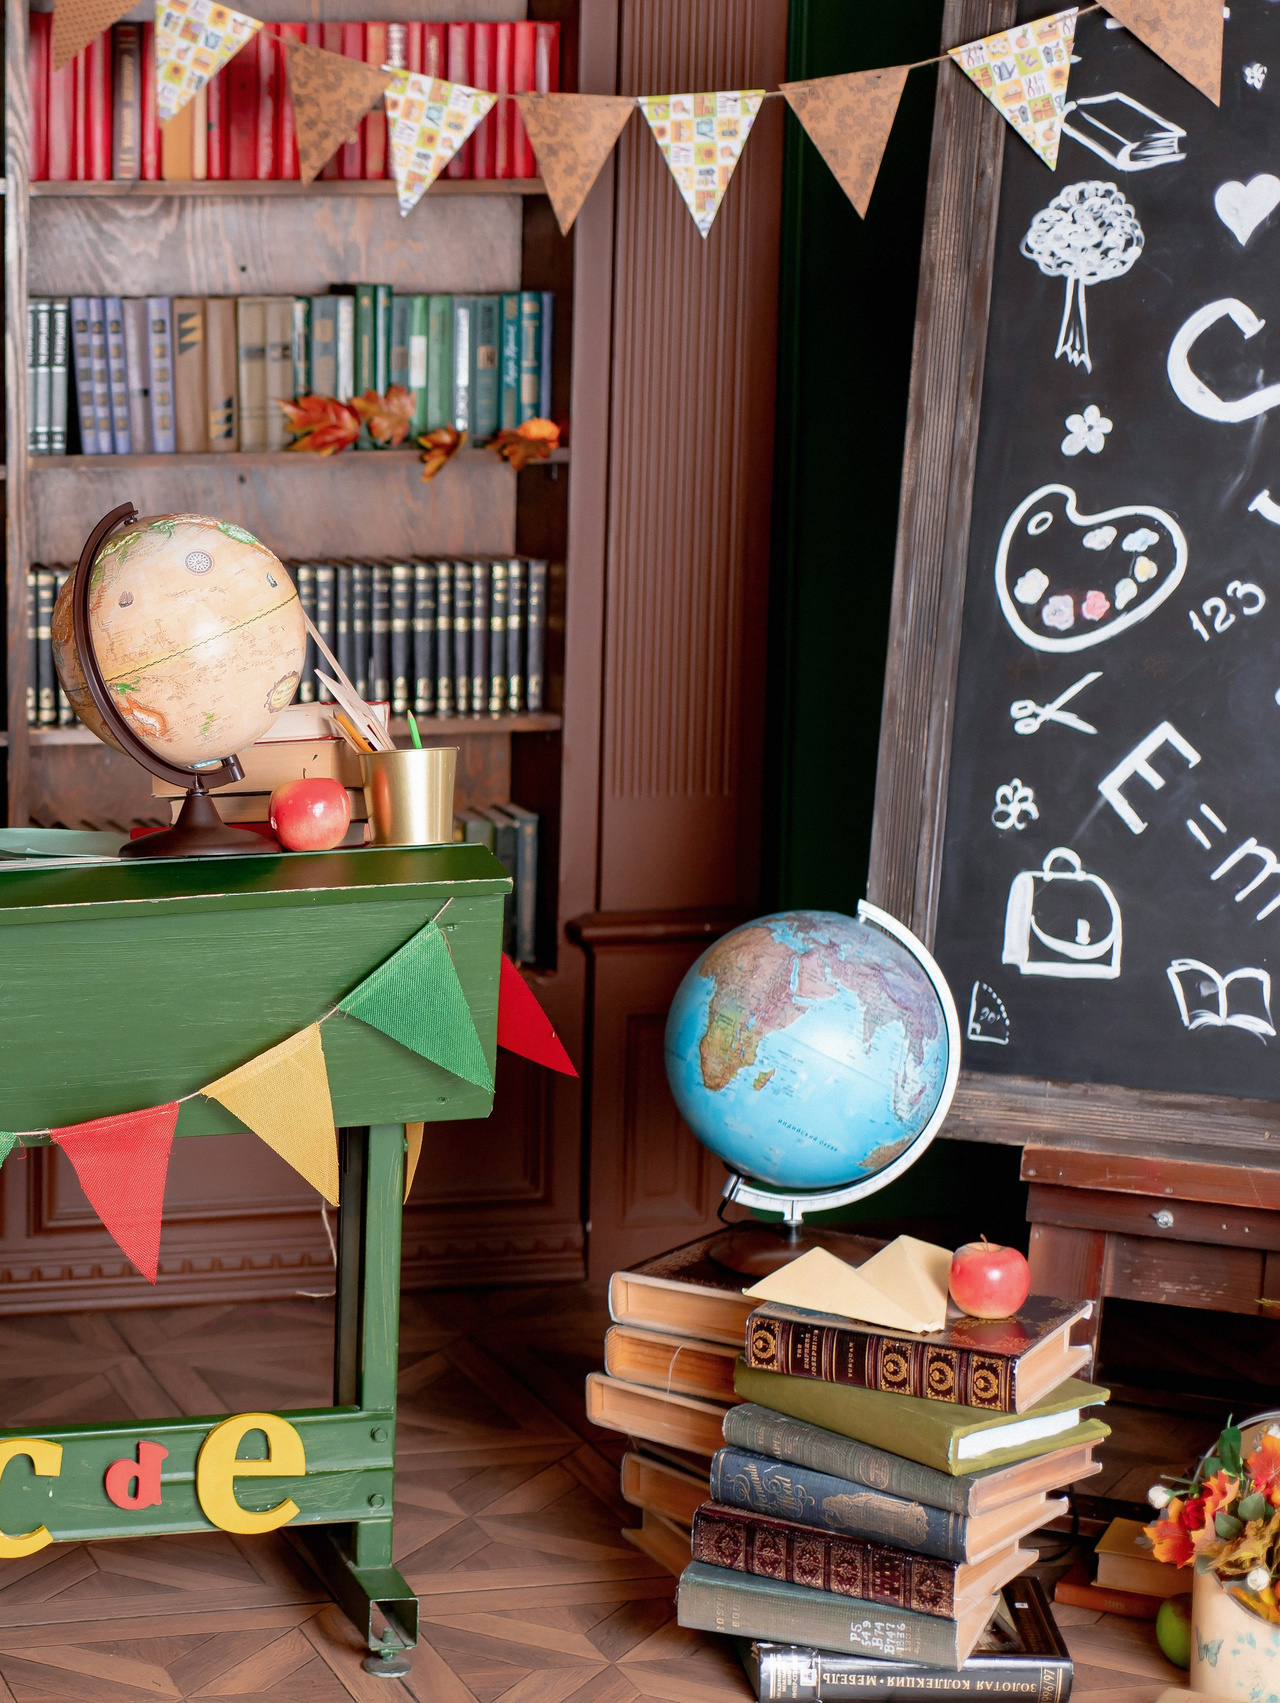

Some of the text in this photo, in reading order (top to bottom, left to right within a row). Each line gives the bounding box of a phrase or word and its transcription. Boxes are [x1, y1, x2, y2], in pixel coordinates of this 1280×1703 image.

[1188, 580, 1266, 642] 123
[803, 1333, 811, 1369] EMPRESS
[811, 1329, 820, 1377] JOSEPHINE
[847, 1341, 855, 1378] TURQUAN
[105, 1440, 170, 1511] d
[196, 1412, 308, 1535] e
[861, 1620, 872, 1648] 549
[884, 1622, 896, 1655] B747
[822, 1673, 1038, 1694] ЗОЛОТАЯ КОЛЛЕКЦИЯ МЕБЕЛЬ
